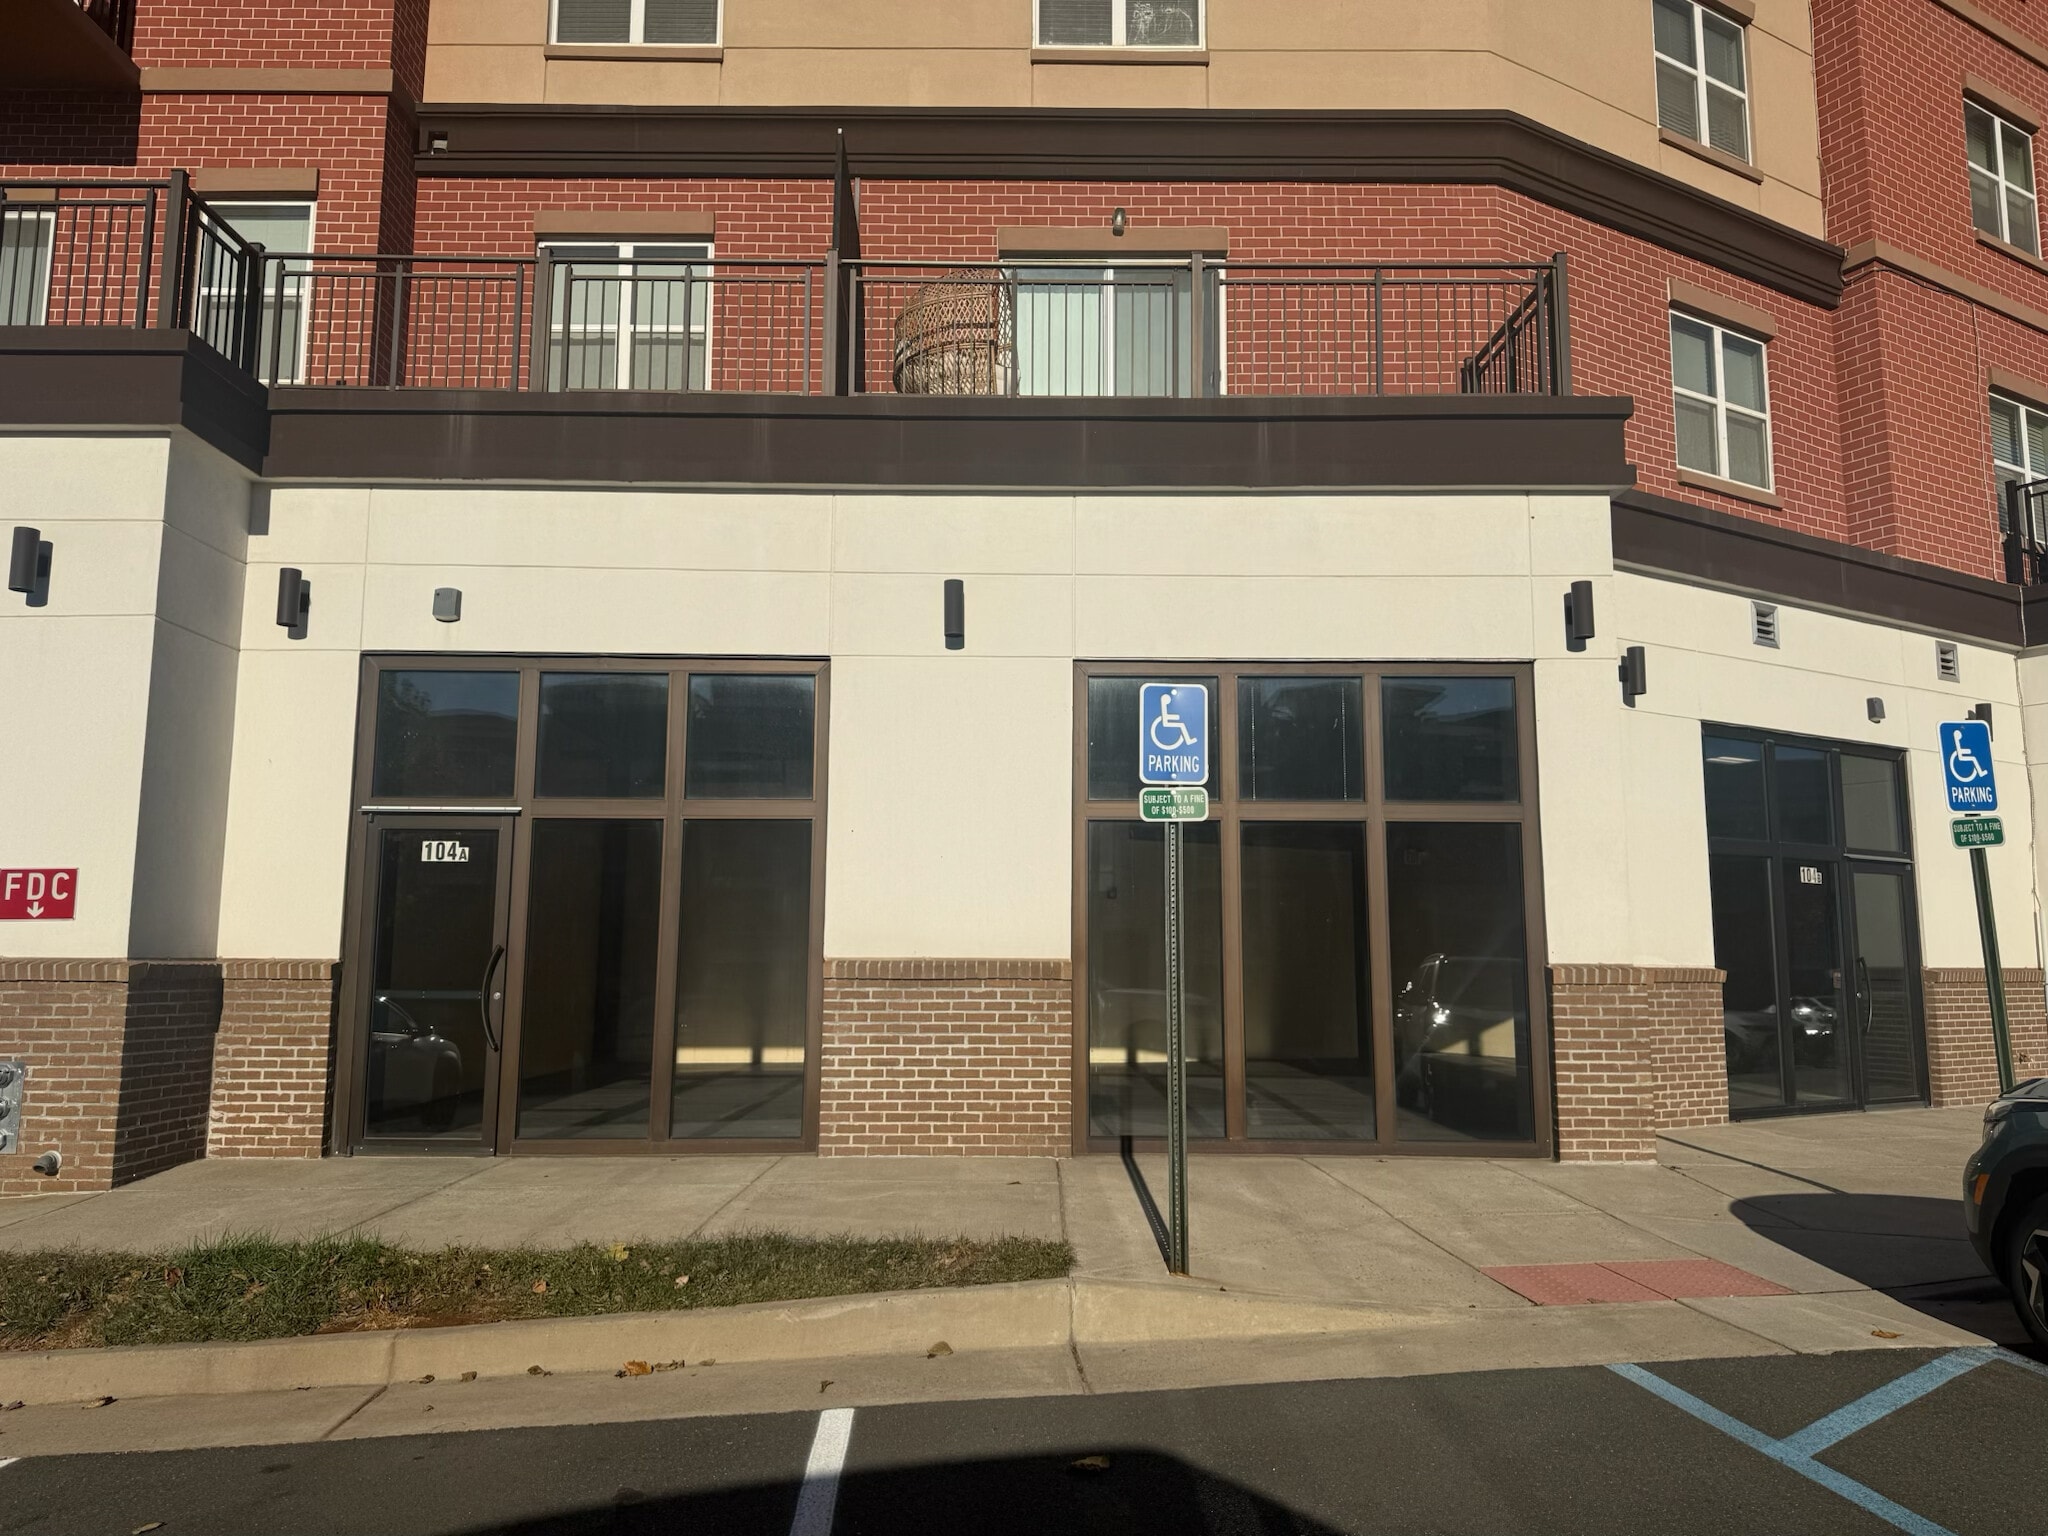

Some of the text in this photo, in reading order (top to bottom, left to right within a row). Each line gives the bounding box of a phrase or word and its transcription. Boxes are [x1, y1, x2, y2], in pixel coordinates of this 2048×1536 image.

[1148, 755, 1200, 773] PARKING
[1143, 794, 1204, 804] SUBJECT TO A FINE
[1951, 786, 1993, 803] PARKING
[1151, 805, 1195, 815] OF $100-$500
[1953, 823, 1974, 832] SUBJECT
[1976, 823, 1983, 831] TO
[1989, 822, 2001, 830] FINE
[1960, 834, 1967, 842] OF
[4, 872, 70, 900] FDC
